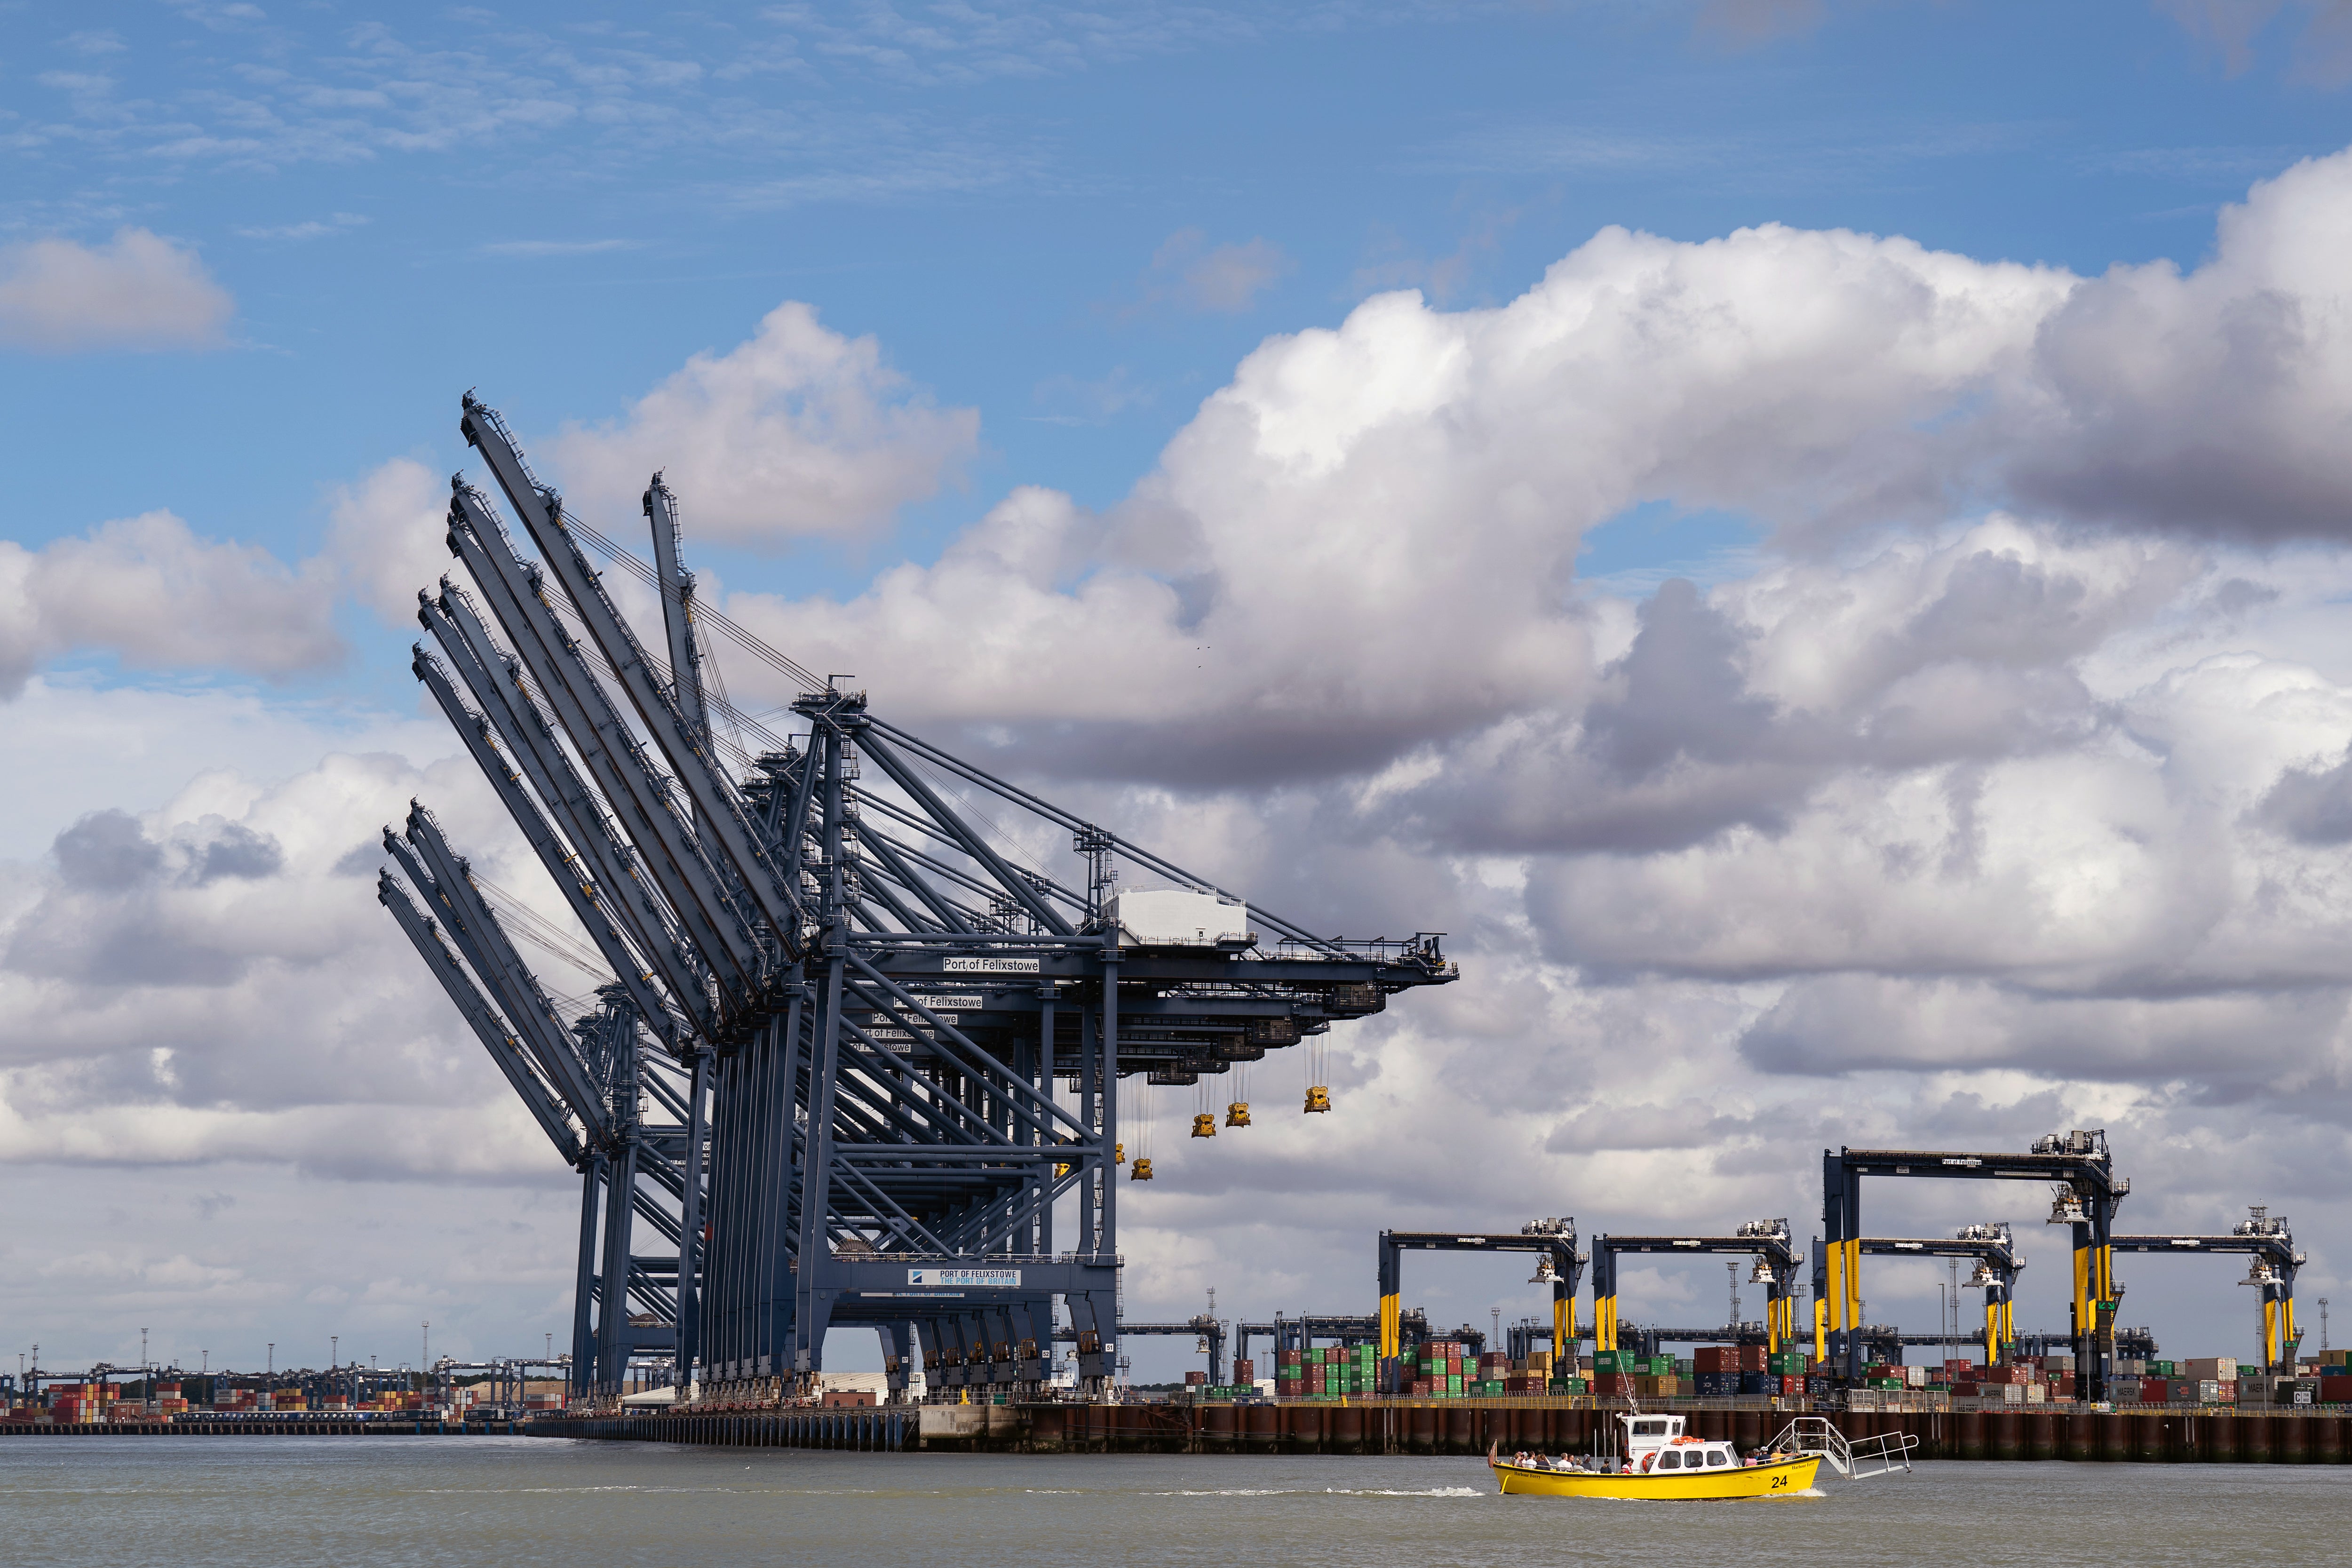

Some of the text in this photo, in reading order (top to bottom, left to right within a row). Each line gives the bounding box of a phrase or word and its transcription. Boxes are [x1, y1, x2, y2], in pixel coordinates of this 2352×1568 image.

[945, 958, 1038, 971] Port of Felixstowe
[918, 996, 928, 1006] of
[930, 996, 982, 1007] Felixstowe
[2117, 1387, 2135, 1396] MAERSK
[2295, 1393, 2300, 1401] C
[1772, 1475, 1788, 1488] 24
